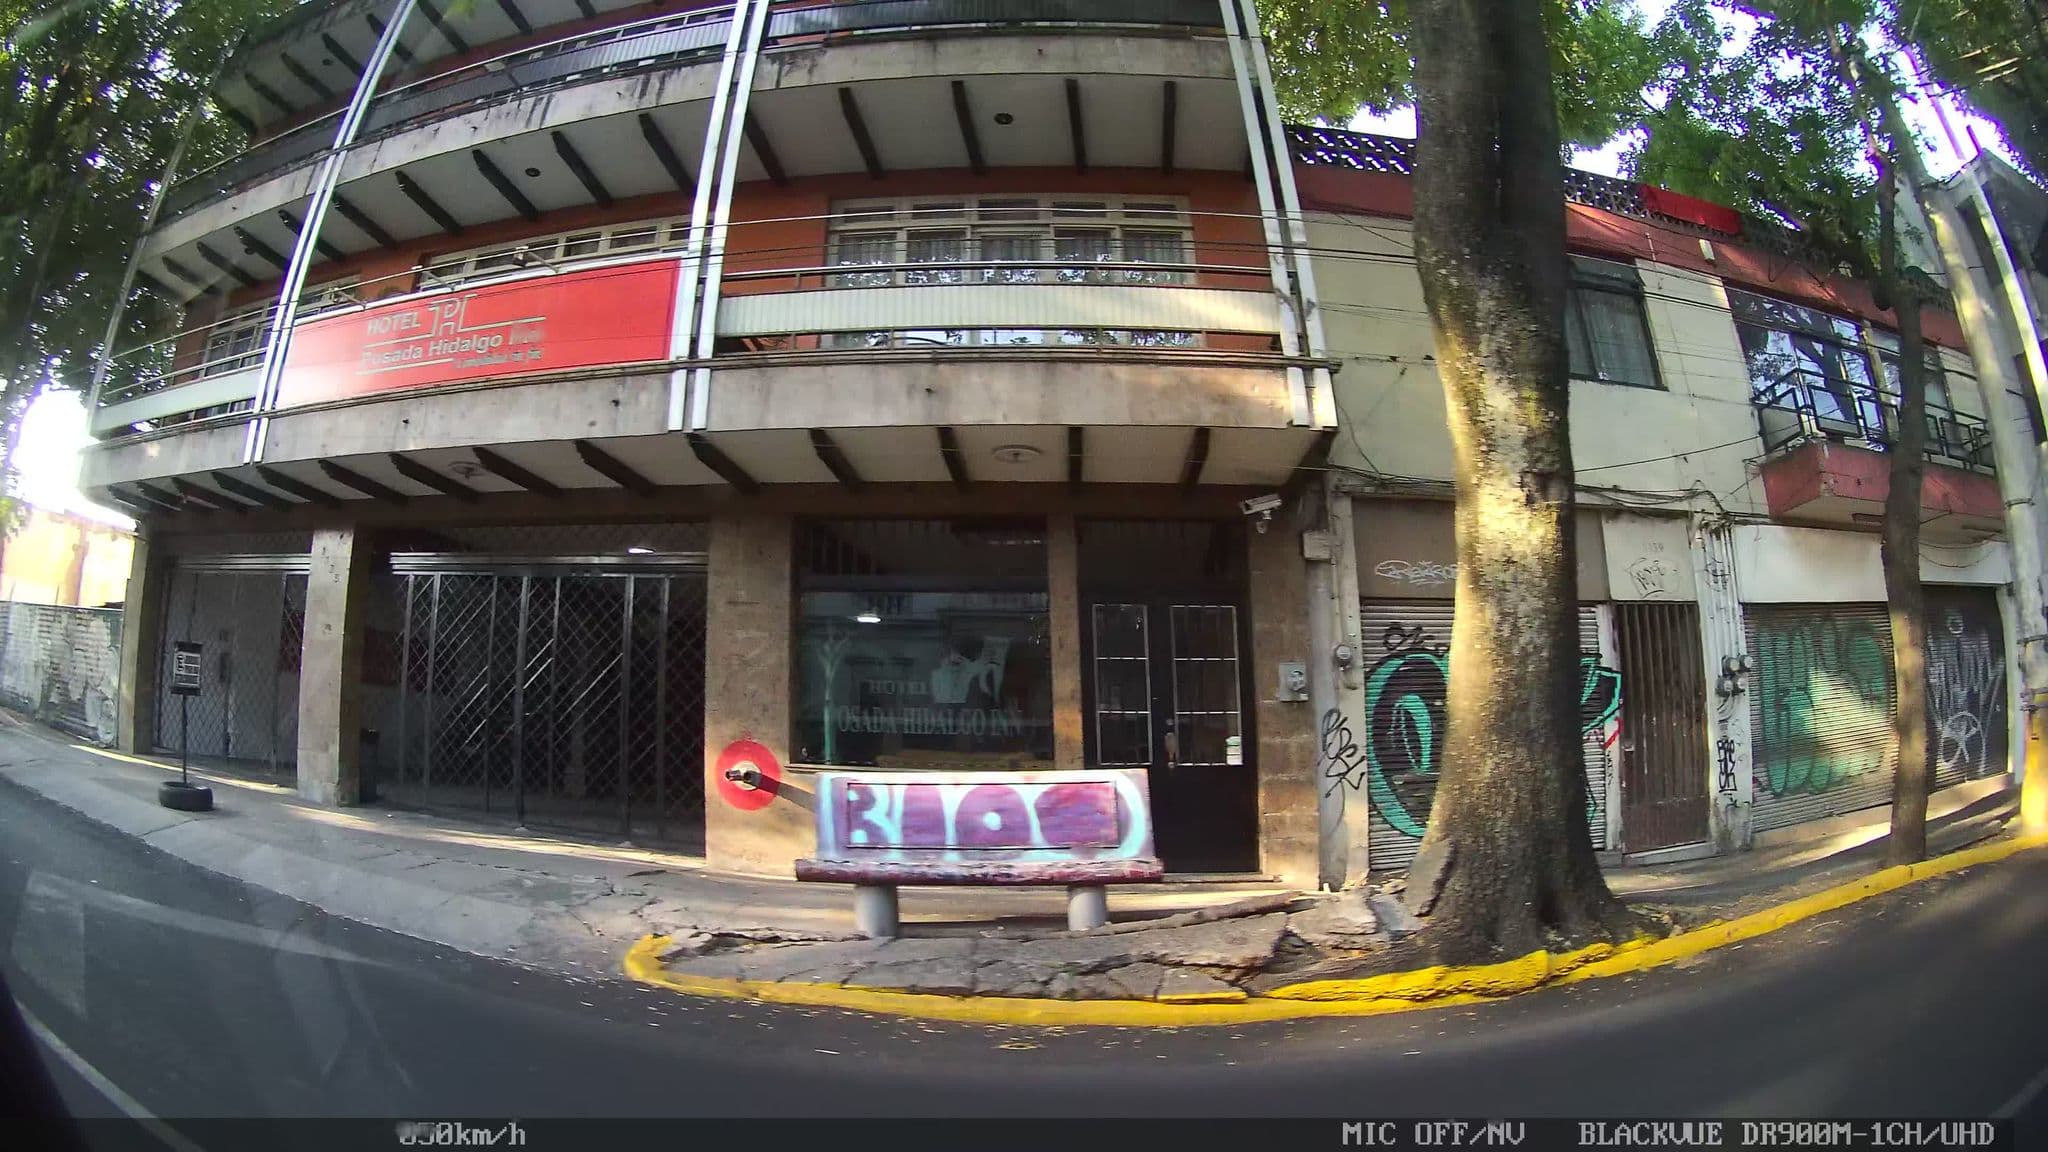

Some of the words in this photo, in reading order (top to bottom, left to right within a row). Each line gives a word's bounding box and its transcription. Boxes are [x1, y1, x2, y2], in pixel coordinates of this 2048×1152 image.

[367, 311, 422, 335] HOTEL
[428, 334, 504, 356] Hidalgo
[902, 706, 988, 737] HIDALGO
